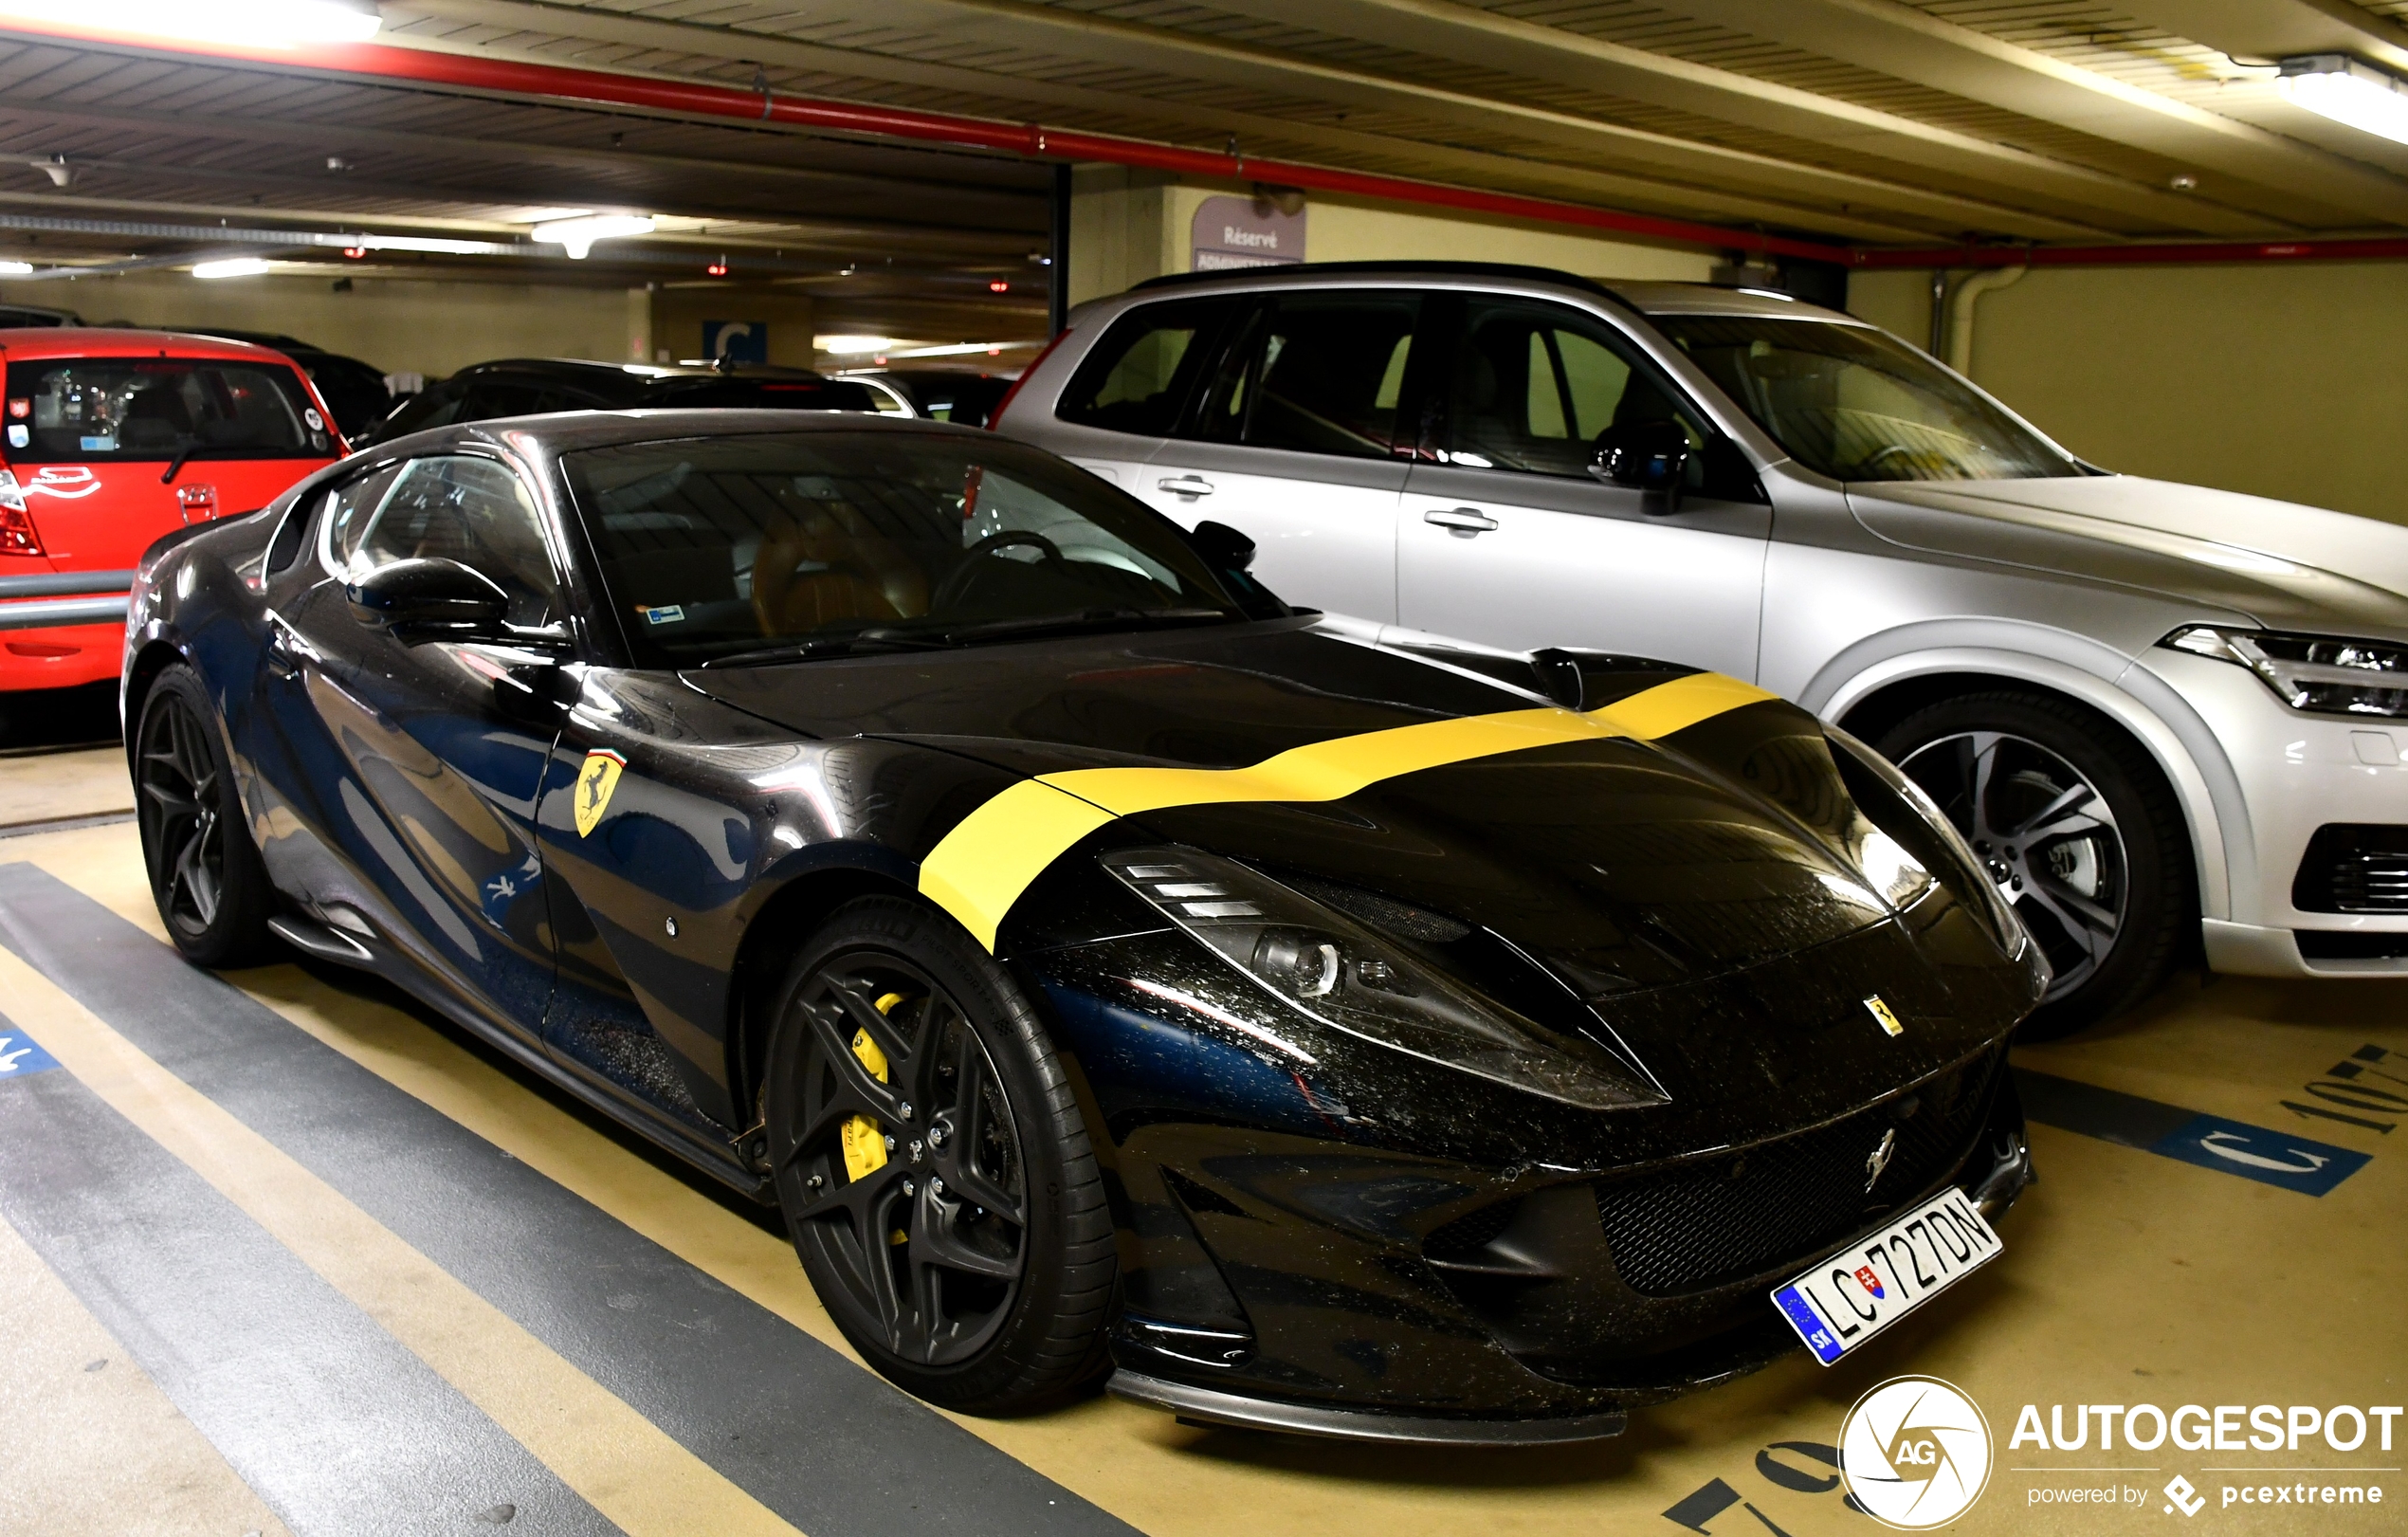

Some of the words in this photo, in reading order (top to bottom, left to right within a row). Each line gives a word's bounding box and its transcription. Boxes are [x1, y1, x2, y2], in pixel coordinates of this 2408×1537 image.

[1223, 226, 1278, 248] Réservé
[921, 934, 953, 958] PILOT
[952, 960, 987, 997] SPORT
[1811, 1328, 1833, 1349] SK
